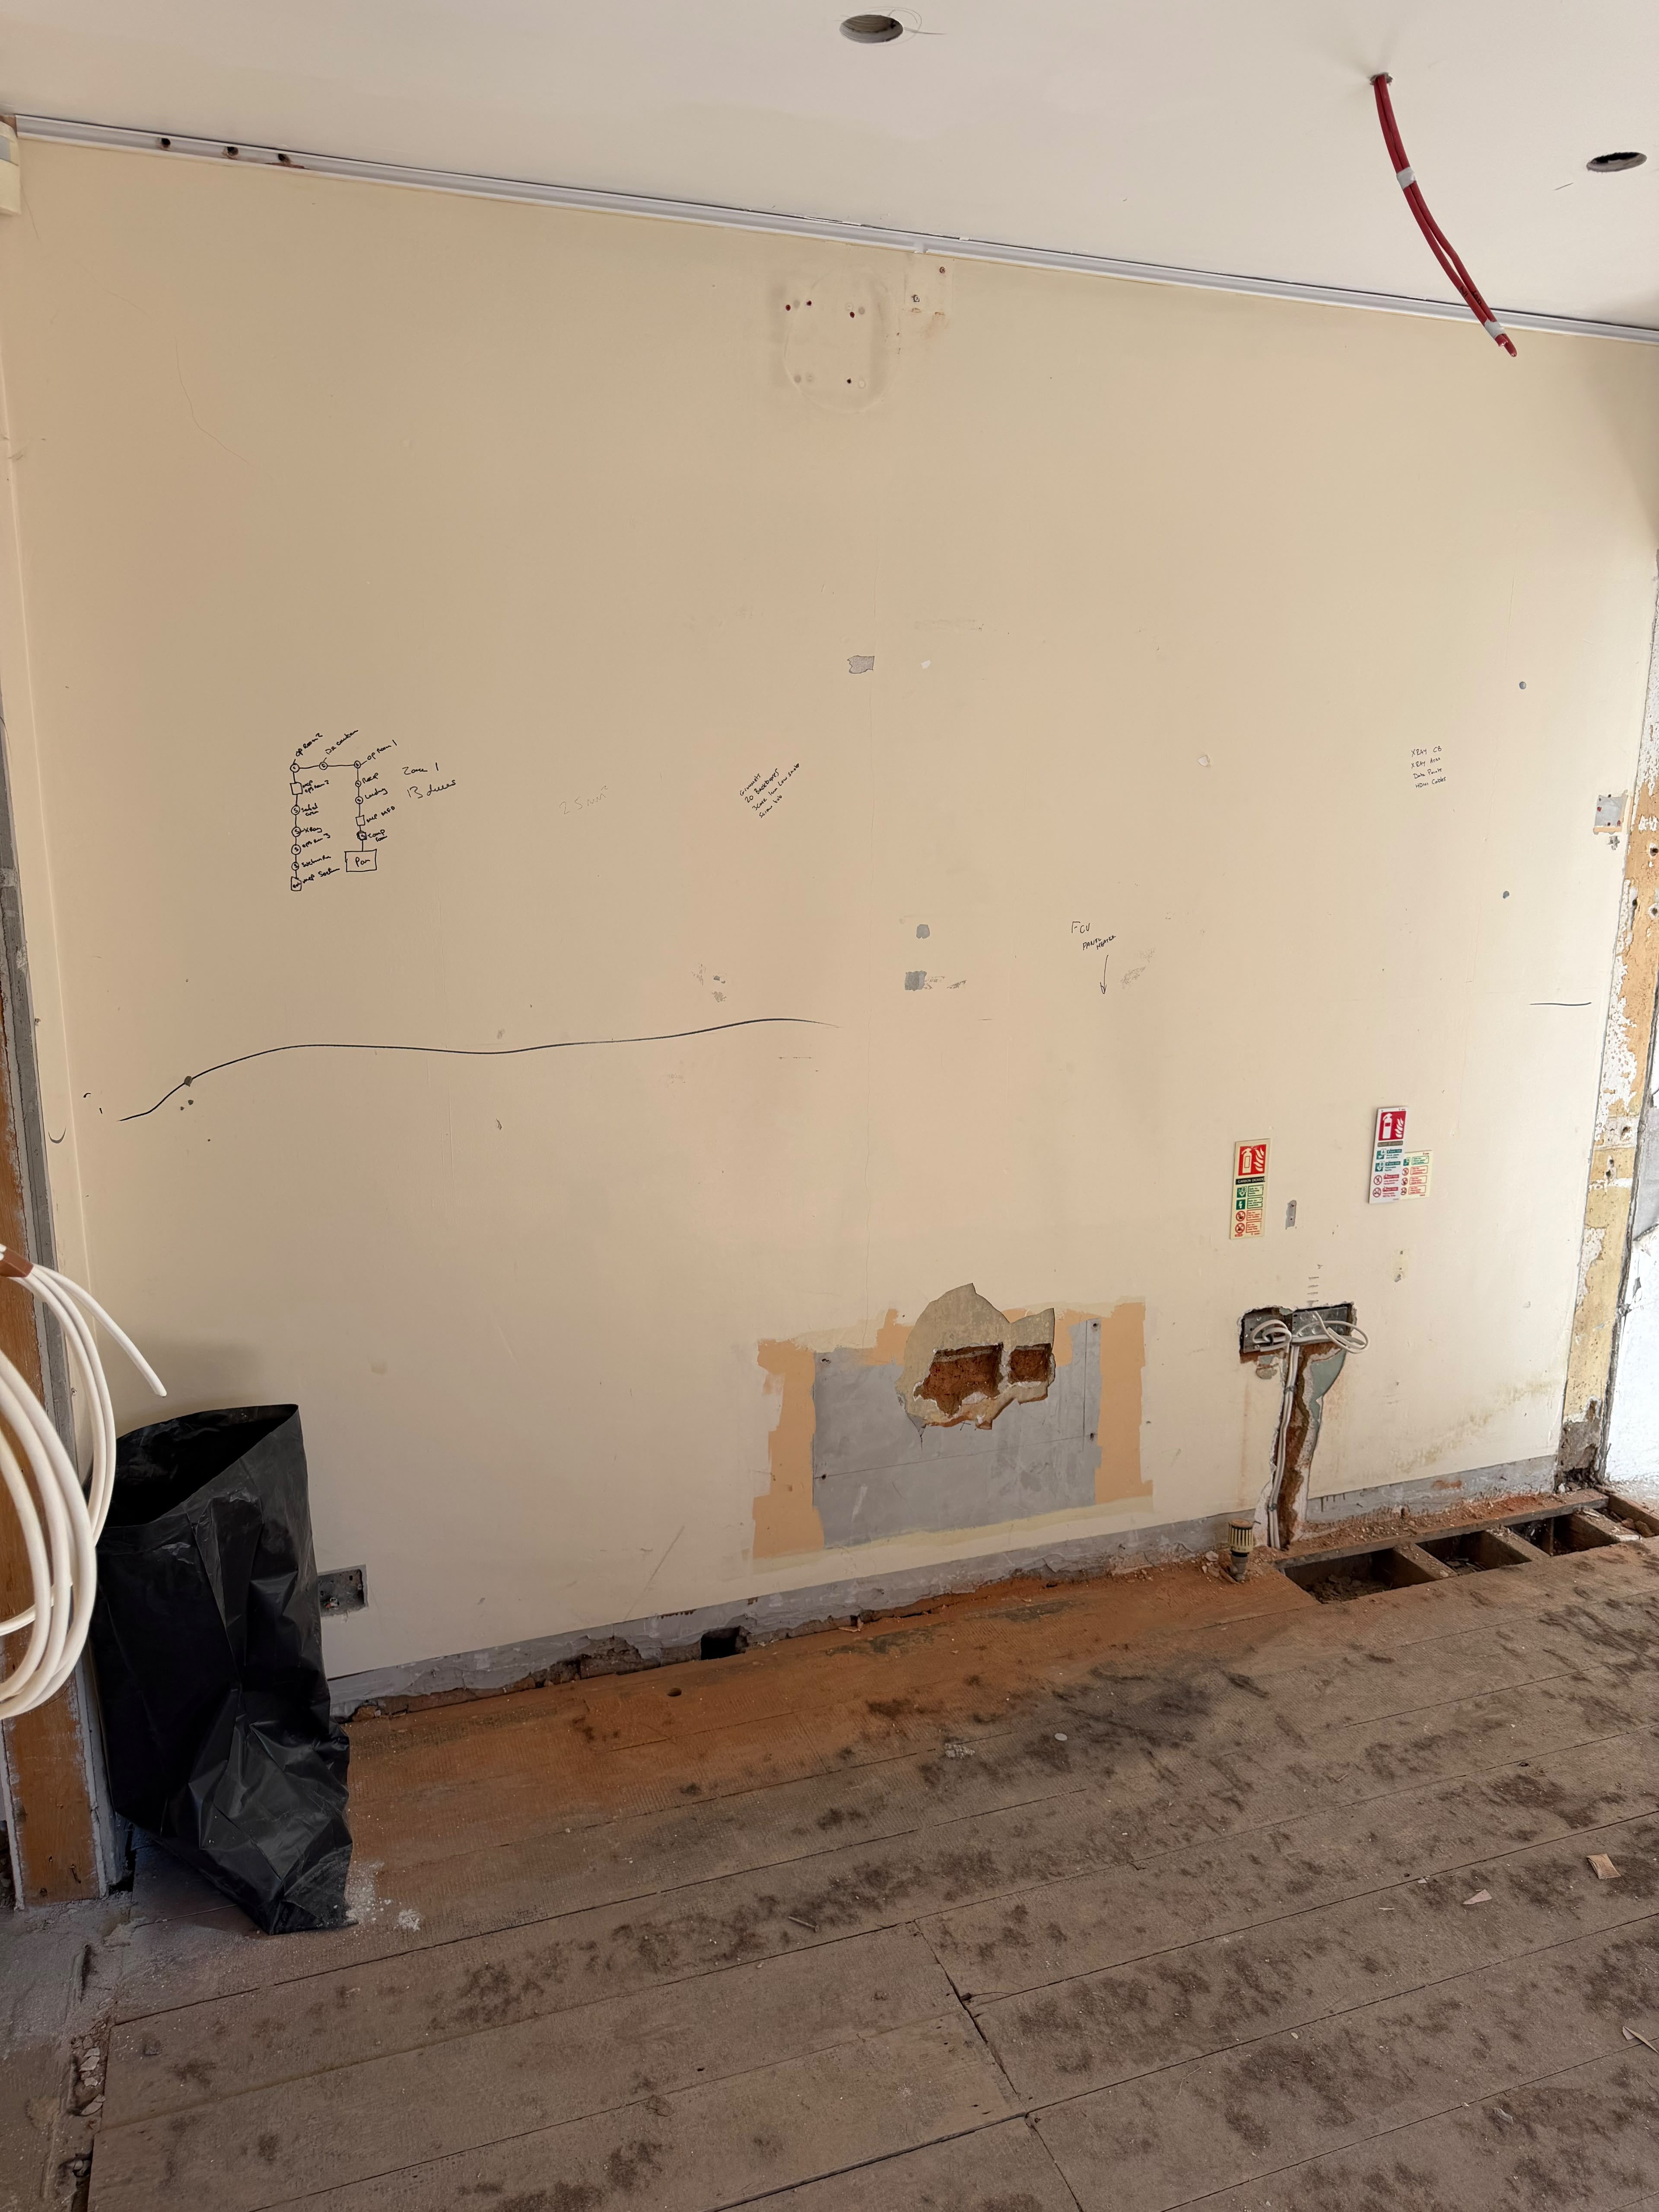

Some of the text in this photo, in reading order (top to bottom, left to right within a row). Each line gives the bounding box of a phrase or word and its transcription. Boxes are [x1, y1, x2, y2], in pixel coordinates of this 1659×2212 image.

[1460, 286, 1468, 297] IN
[435, 762, 439, 771] 1
[1432, 776, 1446, 785] Cables
[407, 786, 423, 799] 13
[1096, 935, 1116, 950] HEATER
